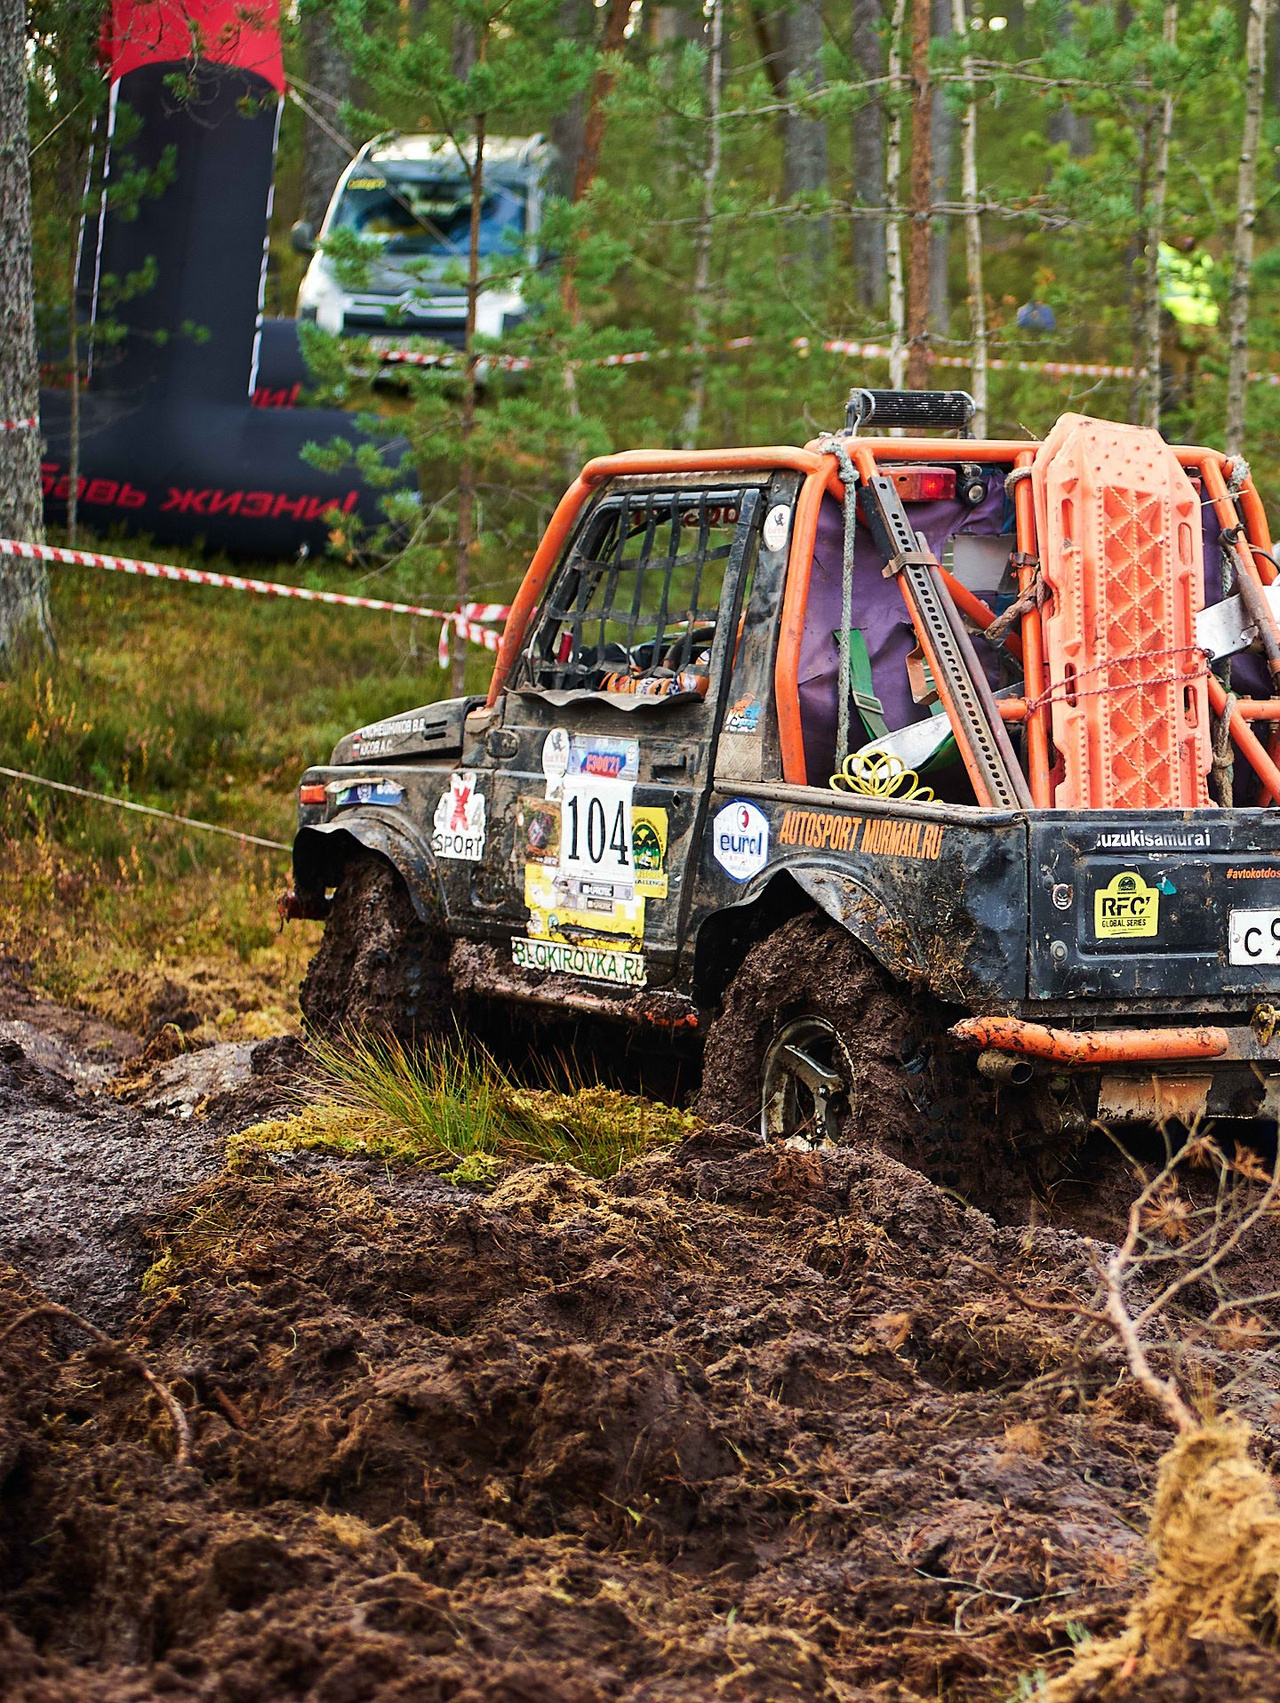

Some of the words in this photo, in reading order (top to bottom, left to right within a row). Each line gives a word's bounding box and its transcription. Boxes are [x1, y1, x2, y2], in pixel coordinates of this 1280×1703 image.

[433, 833, 482, 857] SPORT
[568, 796, 630, 866] 104
[720, 832, 762, 855] eurol
[779, 810, 862, 851] AUTOSPORT
[860, 818, 944, 860] MURMAN.RU
[1102, 919, 1125, 928] GLOBAL
[1126, 918, 1146, 927] SERIES
[513, 940, 646, 981] BLOKIROVKA.RU
